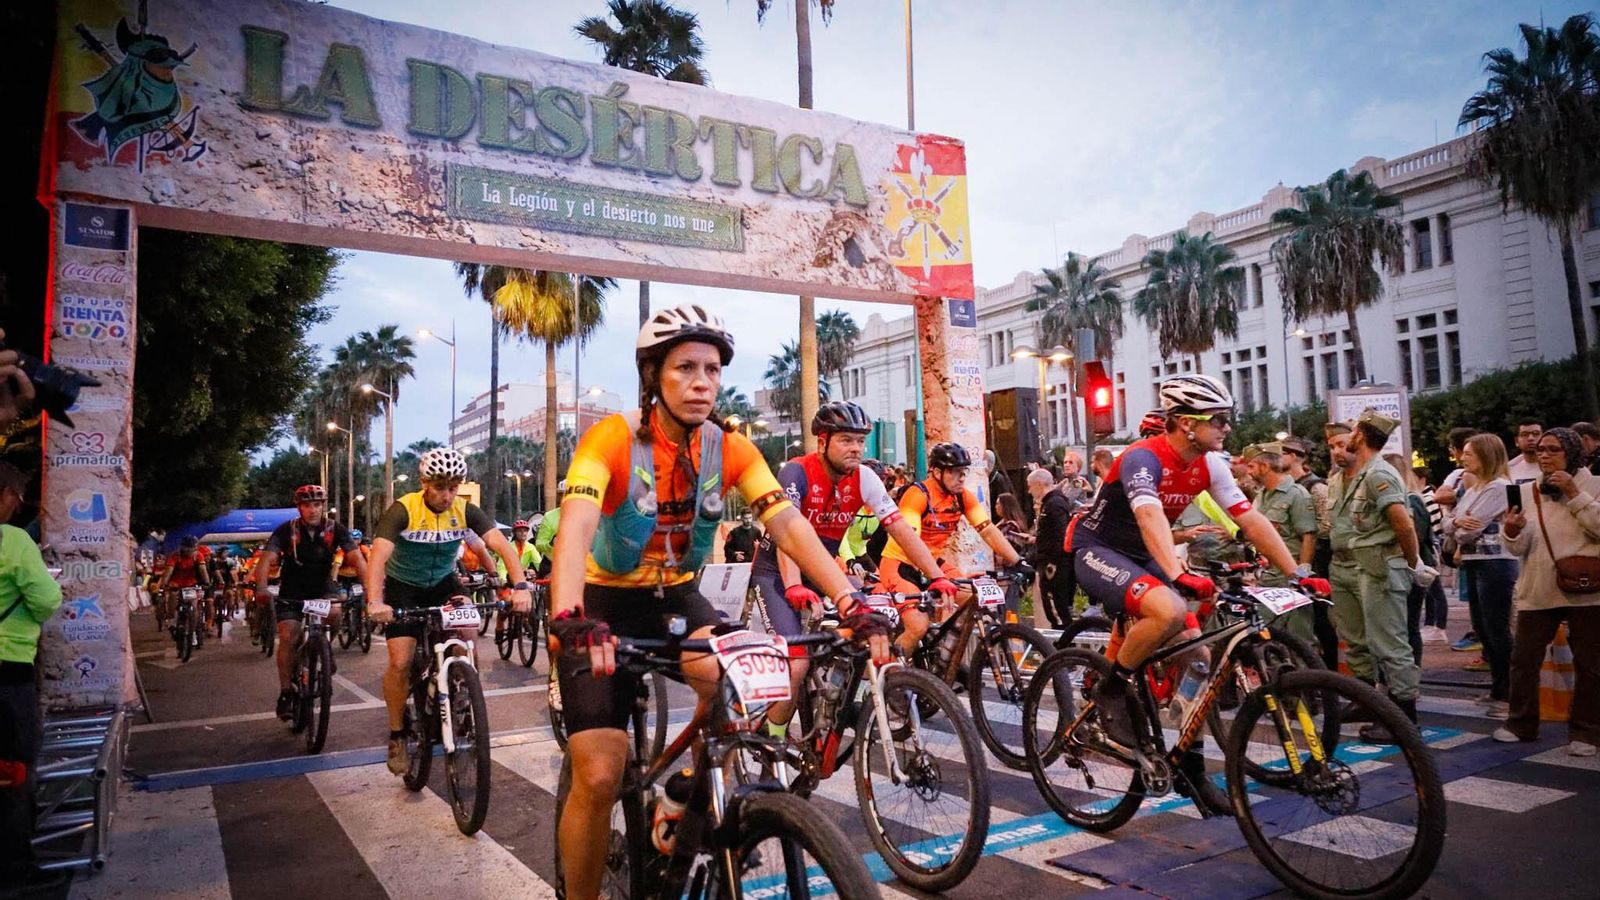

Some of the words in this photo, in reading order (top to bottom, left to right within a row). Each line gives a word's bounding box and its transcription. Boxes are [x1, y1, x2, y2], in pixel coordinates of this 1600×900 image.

[237, 24, 383, 129] LA
[405, 57, 870, 207] DESÉRTICA
[482, 182, 501, 204] La
[509, 187, 558, 212] Legión
[566, 200, 576, 218] y
[583, 199, 595, 217] el
[602, 203, 657, 226] desierto
[664, 213, 686, 229] nos
[692, 217, 715, 234] une
[64, 296, 123, 308] GRUPO
[63, 306, 125, 322] RENTA
[56, 455, 124, 467] primaflor
[70, 534, 106, 543] Activa
[449, 610, 477, 621] 5960
